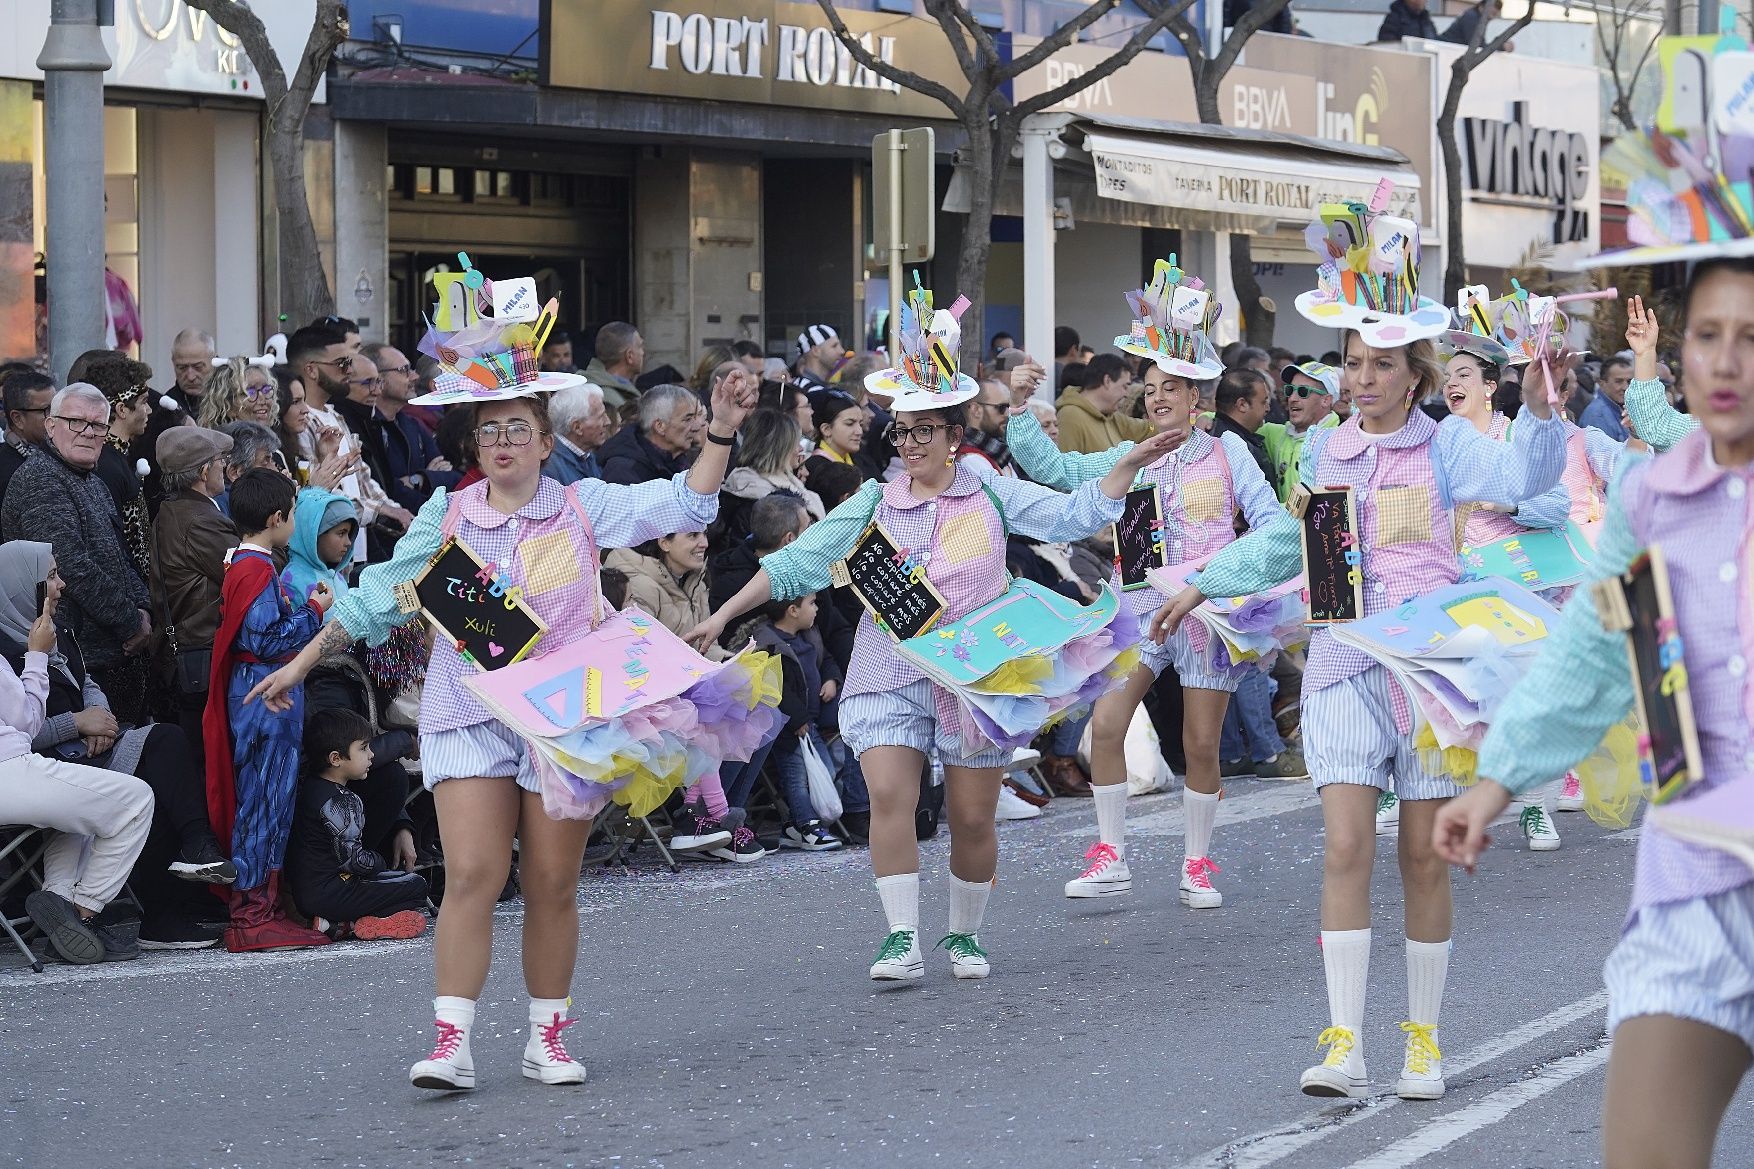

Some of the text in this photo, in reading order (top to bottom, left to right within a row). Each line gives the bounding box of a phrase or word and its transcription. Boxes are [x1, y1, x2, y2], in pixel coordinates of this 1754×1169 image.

[649, 10, 768, 79] PORT
[1234, 84, 1292, 131] BBVA
[1218, 175, 1260, 205] PORT
[1264, 180, 1312, 209] ROYAL
[1381, 231, 1403, 254] MILAN
[502, 286, 528, 314] MILAN
[1177, 297, 1200, 315] MILAN
[863, 550, 875, 563] No
[871, 543, 883, 555] No
[474, 561, 524, 611] ABC
[851, 567, 862, 580] No
[446, 576, 487, 605] Titi
